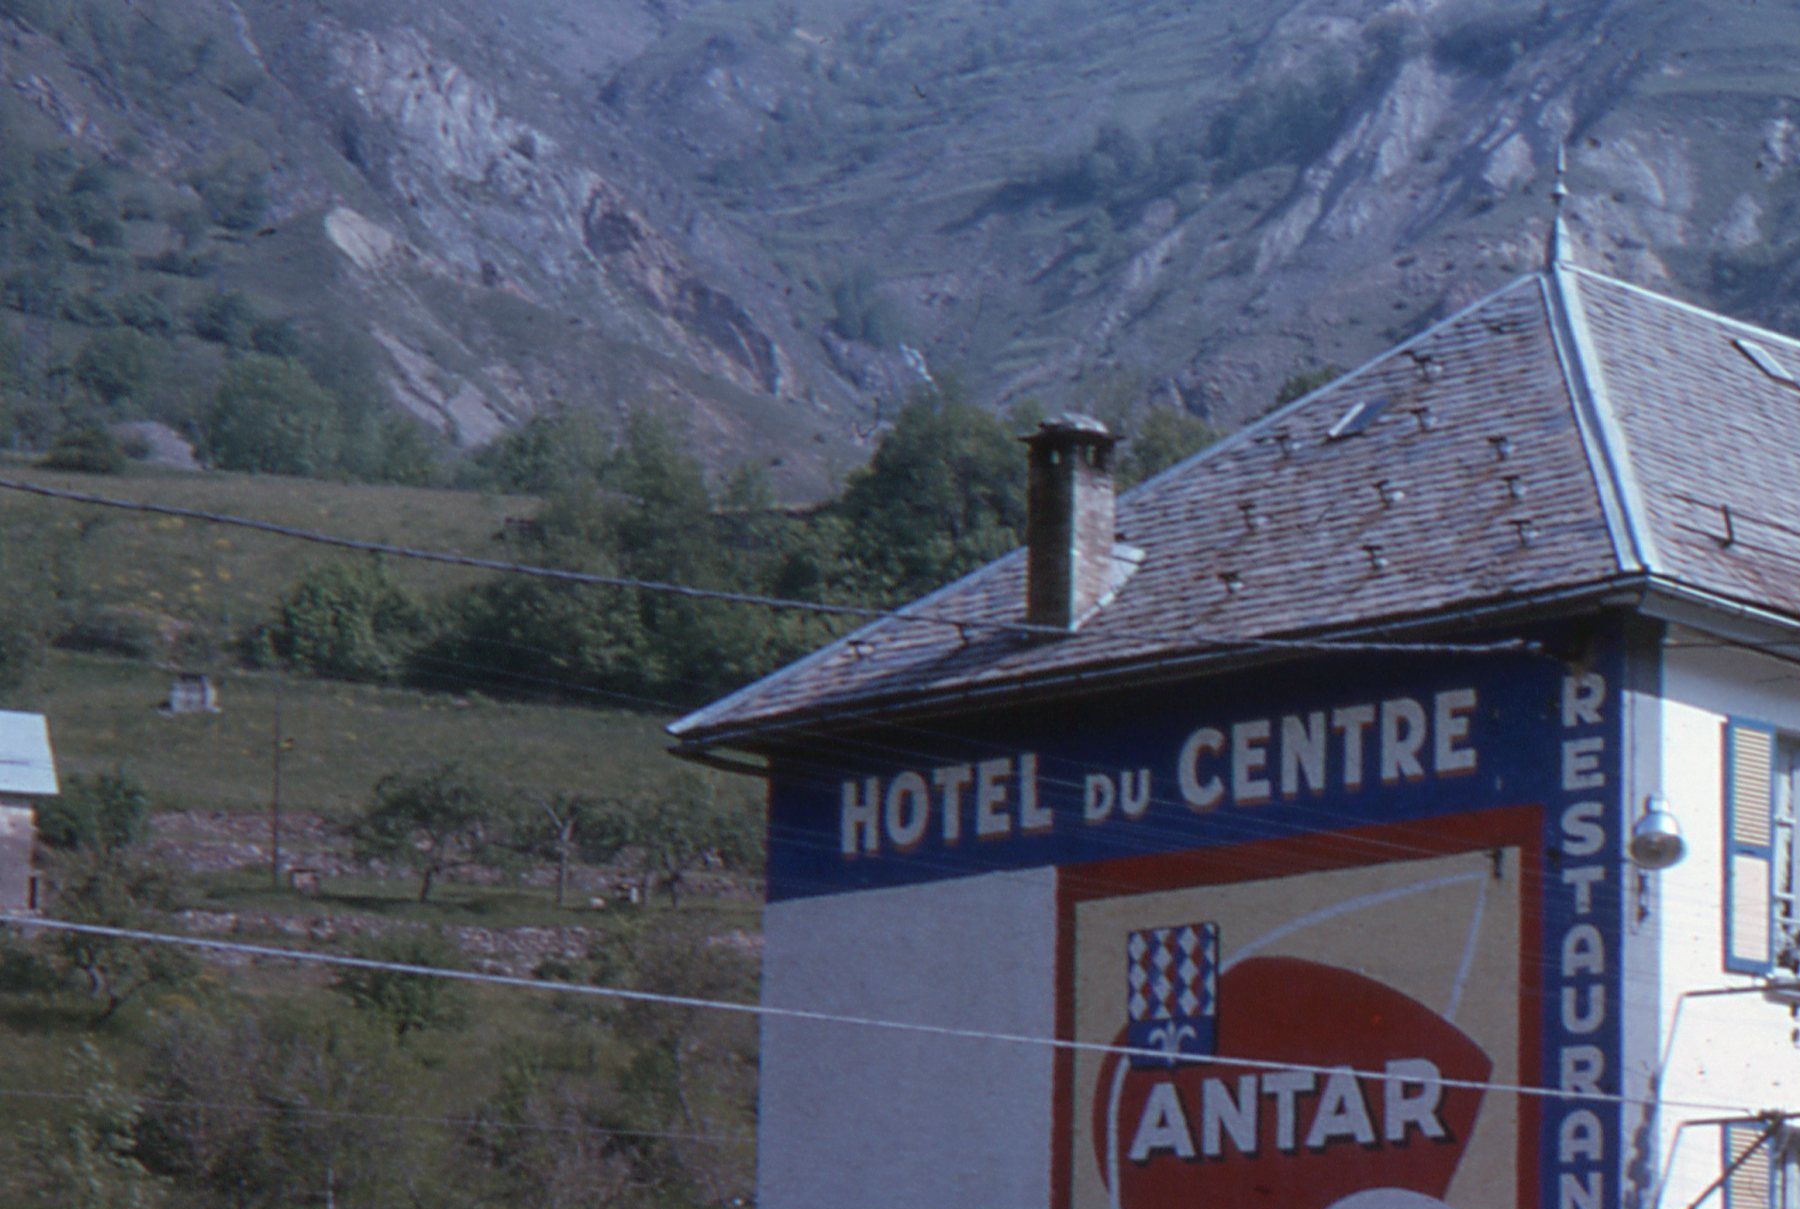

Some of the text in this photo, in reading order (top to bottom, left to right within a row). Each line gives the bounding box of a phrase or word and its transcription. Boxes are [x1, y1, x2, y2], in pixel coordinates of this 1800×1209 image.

[839, 688, 1479, 860] HOTEL DU CENTRE
[1128, 1056, 1455, 1165] ANTAR
